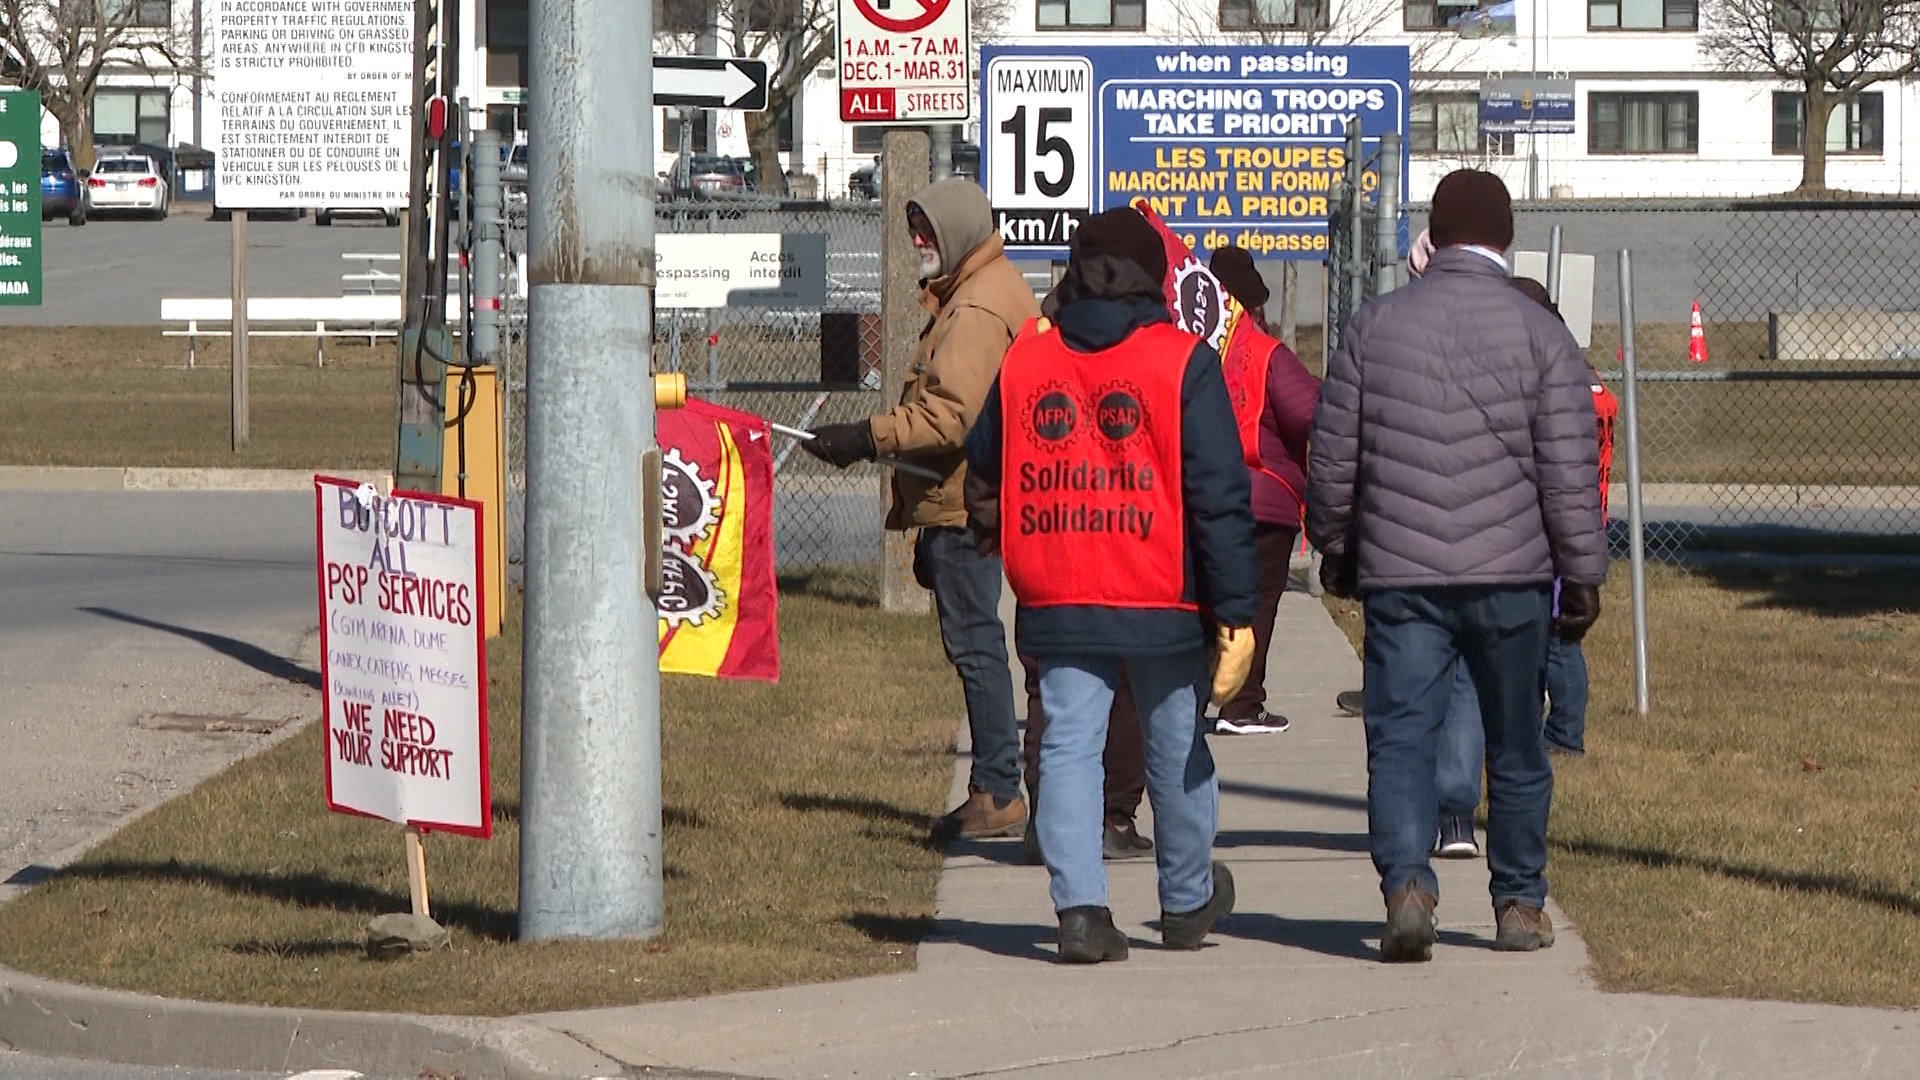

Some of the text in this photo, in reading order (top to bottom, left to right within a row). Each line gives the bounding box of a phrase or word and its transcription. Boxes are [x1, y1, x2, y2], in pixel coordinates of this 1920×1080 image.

[220, 1, 232, 12] IN
[235, 1, 308, 12] ACCORDANCE
[312, 1, 341, 12] WITH
[221, 15, 278, 26] PROPERTY
[282, 15, 328, 26] TRAFFIC
[221, 29, 409, 40] PARKING OR DRIVING ON GRASSED
[264, 42, 327, 54] ANYWHERE
[331, 42, 341, 54] IN
[345, 42, 366, 54] CFB
[369, 42, 414, 54] KINGSTO
[221, 56, 231, 68] IS
[235, 56, 285, 68] STRICTLY
[1155, 51, 1348, 77] when passing
[347, 72, 412, 80] BY ORDER OF M
[998, 69, 1084, 93] MAXIMUM
[315, 91, 330, 104] AU
[849, 93, 890, 114] ALL
[907, 93, 965, 112] STREETS
[1115, 89, 1385, 110] MARCHING TROOPS
[0, 99, 7, 112] E
[221, 105, 264, 117] RELATIF
[279, 105, 293, 117] LA
[297, 105, 367, 117] CIRCULATION
[371, 105, 393, 117] SUR
[222, 119, 276, 131] TERRAINS
[280, 119, 295, 131] DU
[394, 119, 402, 131] IL
[1143, 113, 1357, 134] TAKE PRIORITY
[221, 133, 390, 145] EST STRICTEMENT INTERDIT DE
[222, 147, 400, 158] STATIONNER OU DE CONDUIRE UN
[1001, 105, 1075, 198] 15
[1155, 147, 1346, 169] LES TROUPES
[278, 160, 299, 172] SUR
[303, 160, 323, 172] LES
[327, 160, 382, 172] PELOUSES
[385, 160, 399, 172] DE
[403, 160, 409, 172] L
[12, 181, 28, 194] les
[222, 174, 242, 186] BFC
[1109, 171, 1229, 192] MARCHANT
[1236, 171, 1264, 192] EN
[279, 191, 295, 199] PAR
[299, 191, 325, 199] ORDRE
[329, 191, 341, 199] DU
[344, 191, 382, 199] MINISTRE
[386, 191, 396, 199] DE
[12, 199, 28, 212] les
[1196, 195, 1233, 217] LA
[0, 234, 32, 248] déraux
[1203, 229, 1230, 249] de
[655, 253, 664, 263] o
[656, 265, 731, 281] espassing
[749, 265, 803, 278] interdit
[0, 281, 29, 294] NADA
[1036, 408, 1073, 427] AFPC
[1099, 407, 1137, 426] PSAC
[1019, 459, 1155, 493] Solidarité
[338, 487, 455, 546] BOYCOTT
[1019, 502, 1154, 541] Solidarity
[368, 537, 417, 578] ALL
[327, 563, 472, 626] PSP SERVICES
[342, 699, 436, 746] WE NEED
[332, 727, 454, 782] YOUR SUPPORT
